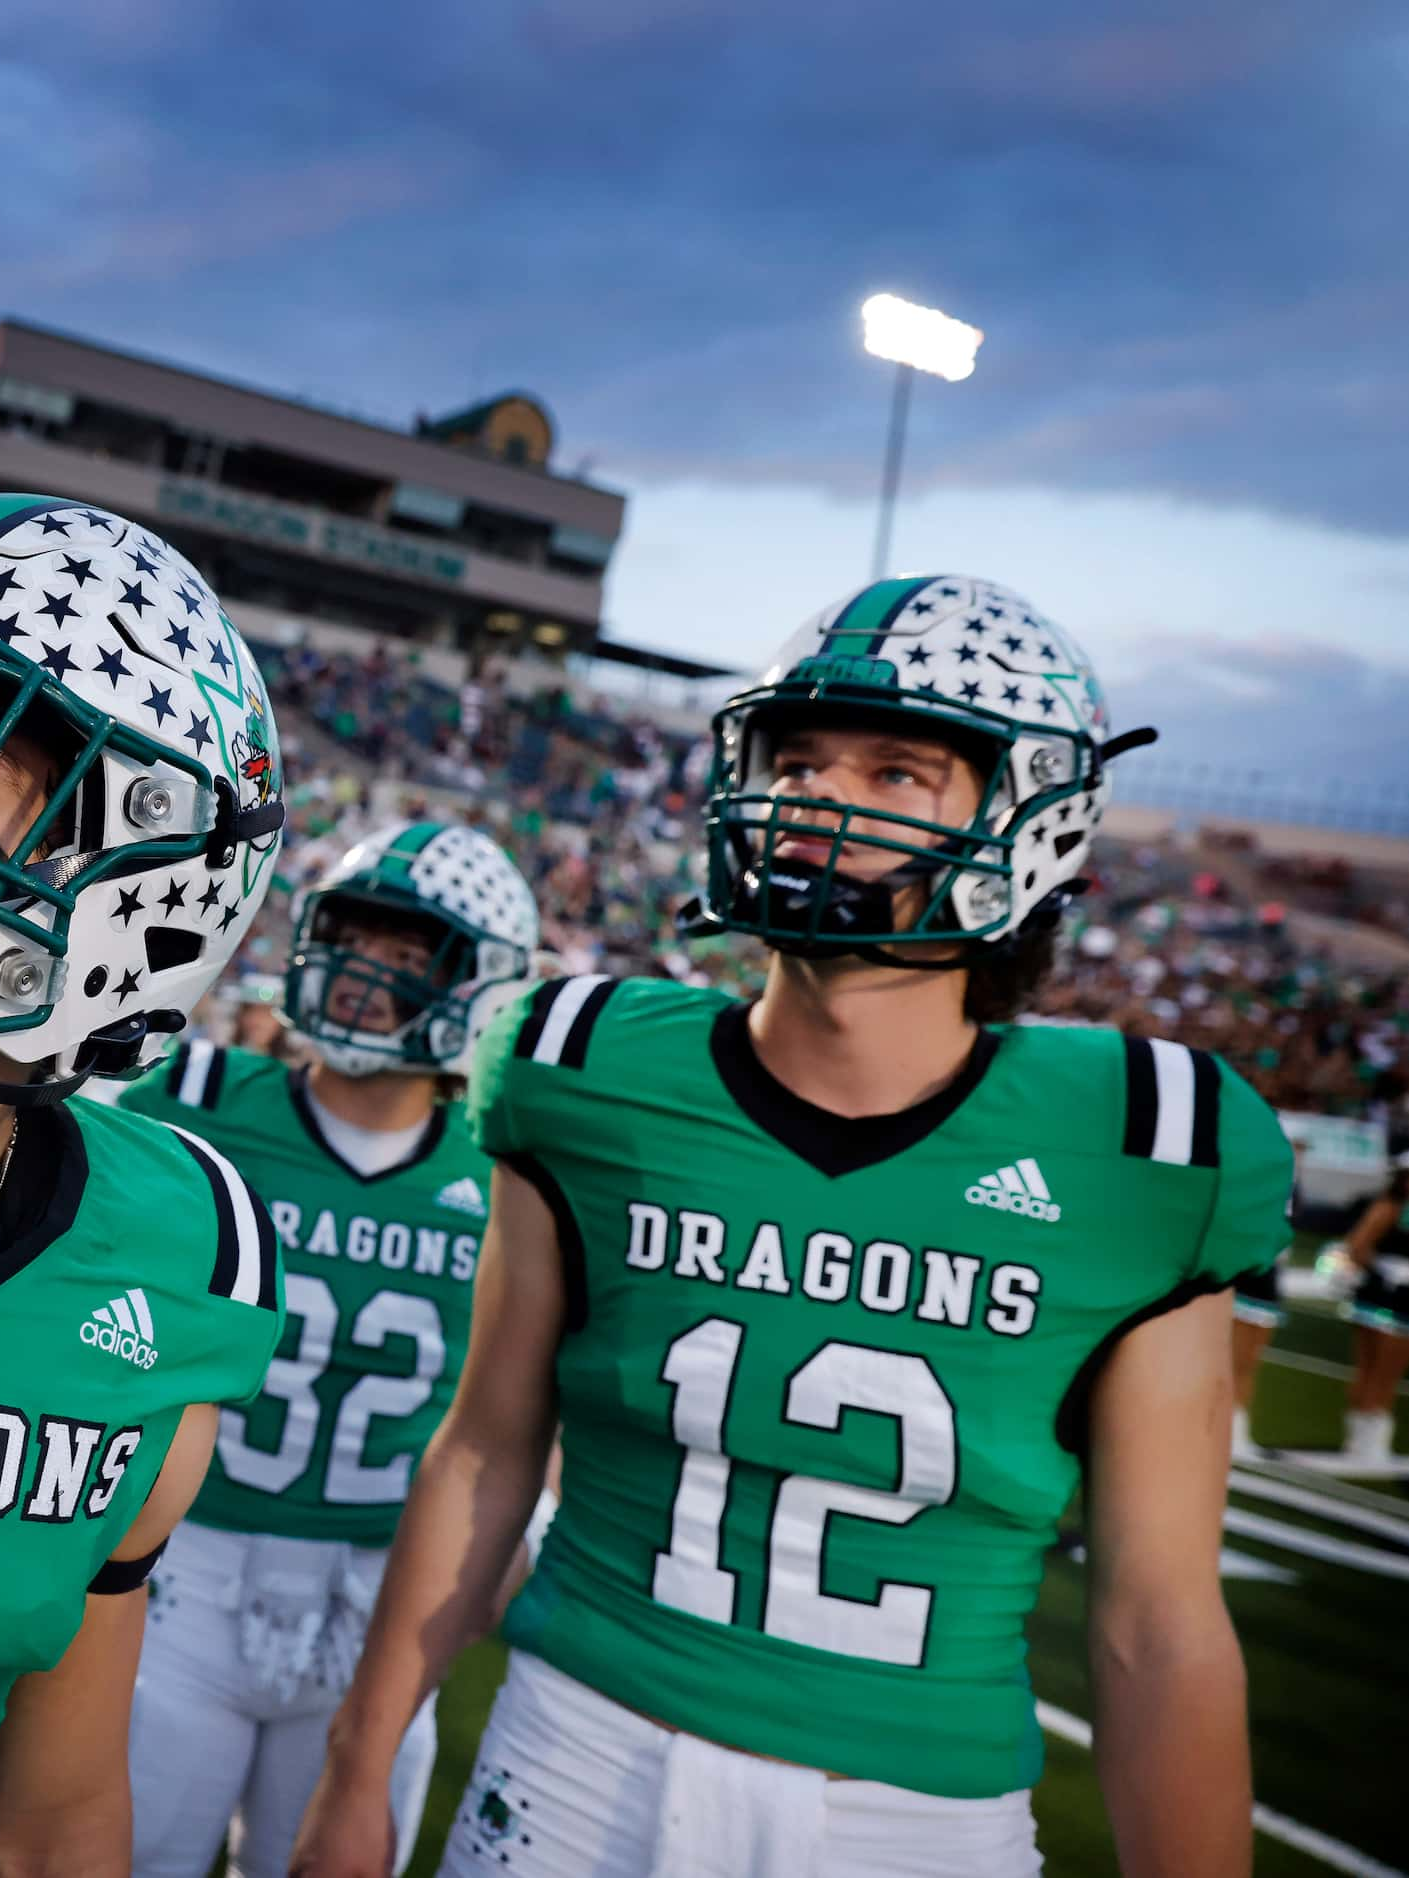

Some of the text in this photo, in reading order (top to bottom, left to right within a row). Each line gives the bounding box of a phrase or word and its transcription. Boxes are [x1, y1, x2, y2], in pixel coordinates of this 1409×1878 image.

[270, 1198, 479, 1282] RAGONS
[964, 1185, 1062, 1222] adidas
[623, 1199, 1045, 1339] DRAGONS
[79, 1321, 159, 1370] adidas
[215, 1272, 447, 1504] 32
[649, 1313, 960, 1668] 12
